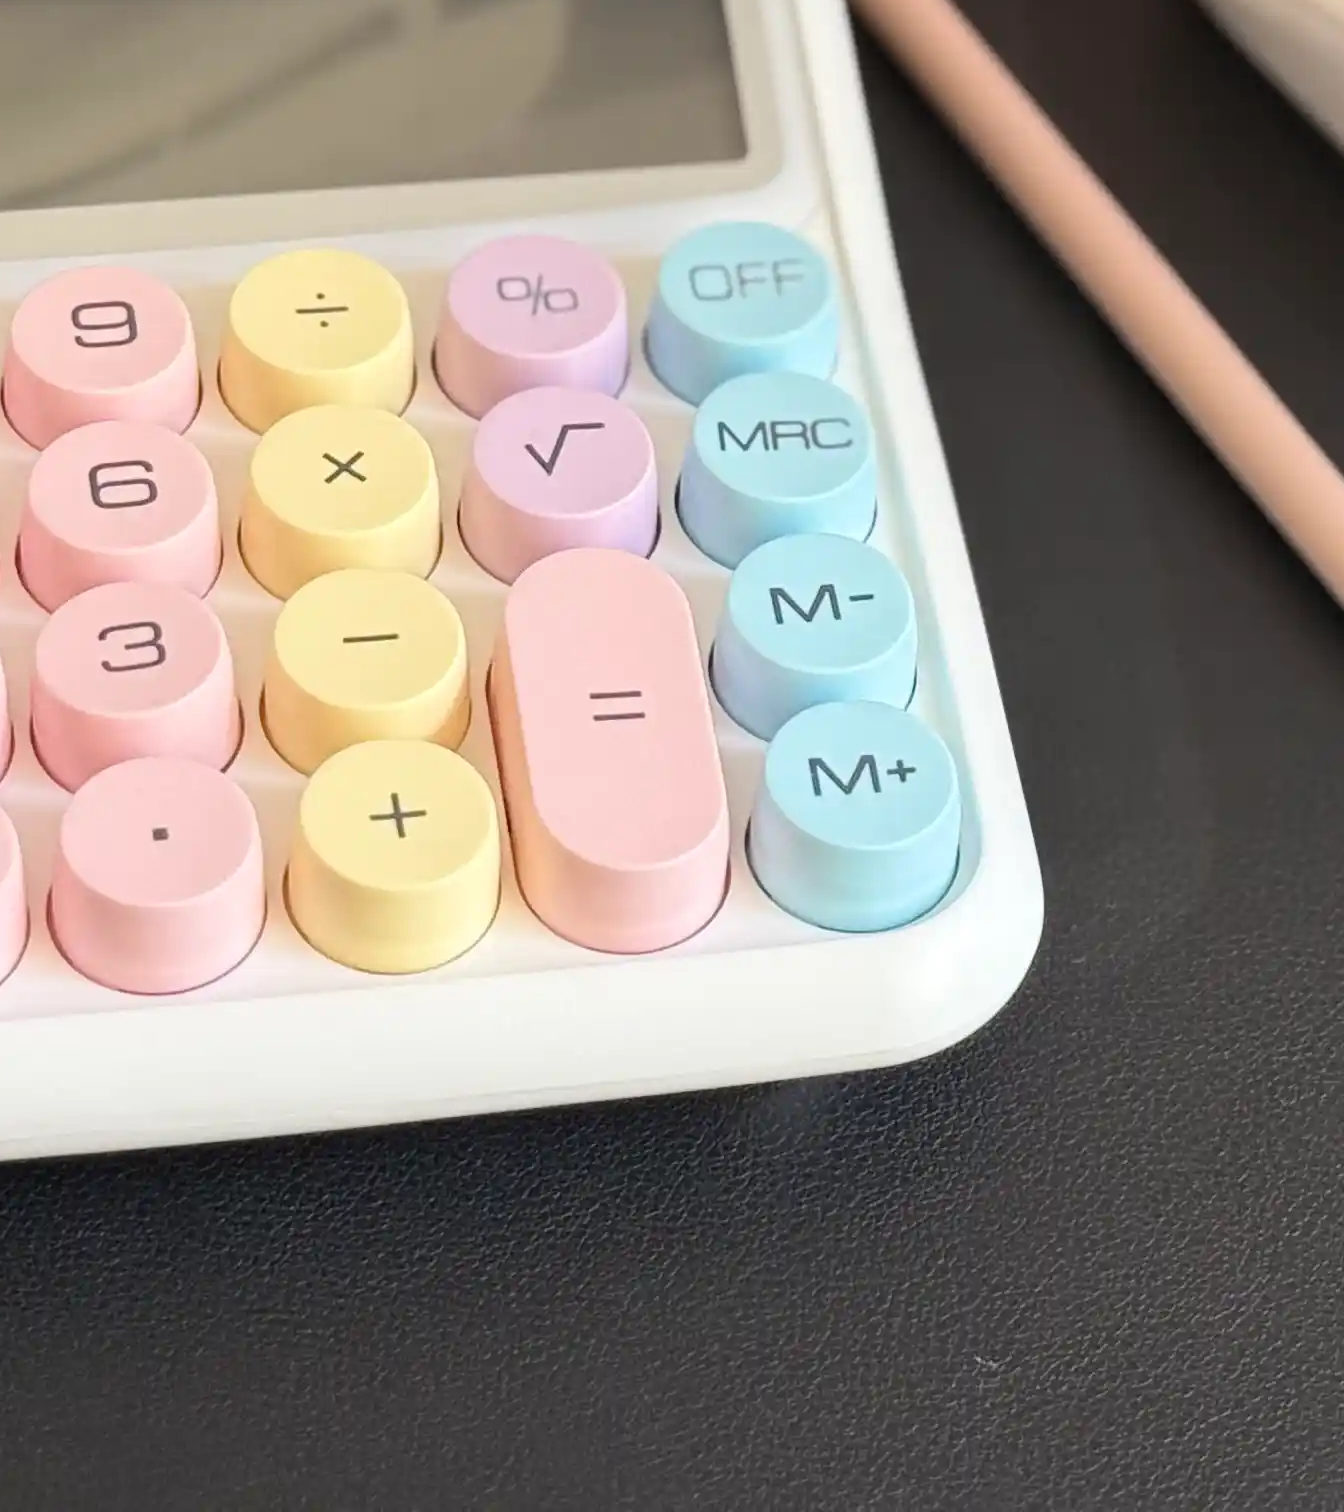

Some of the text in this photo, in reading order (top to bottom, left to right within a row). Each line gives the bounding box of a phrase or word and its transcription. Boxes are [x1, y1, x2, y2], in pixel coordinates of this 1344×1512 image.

[496, 274, 580, 317] %
[688, 257, 805, 302] OFF
[70, 300, 138, 349] 9
[717, 418, 853, 452] MRC
[87, 459, 158, 510] 6
[768, 583, 875, 625] M-
[97, 621, 167, 673] 3
[807, 754, 917, 797] M+
